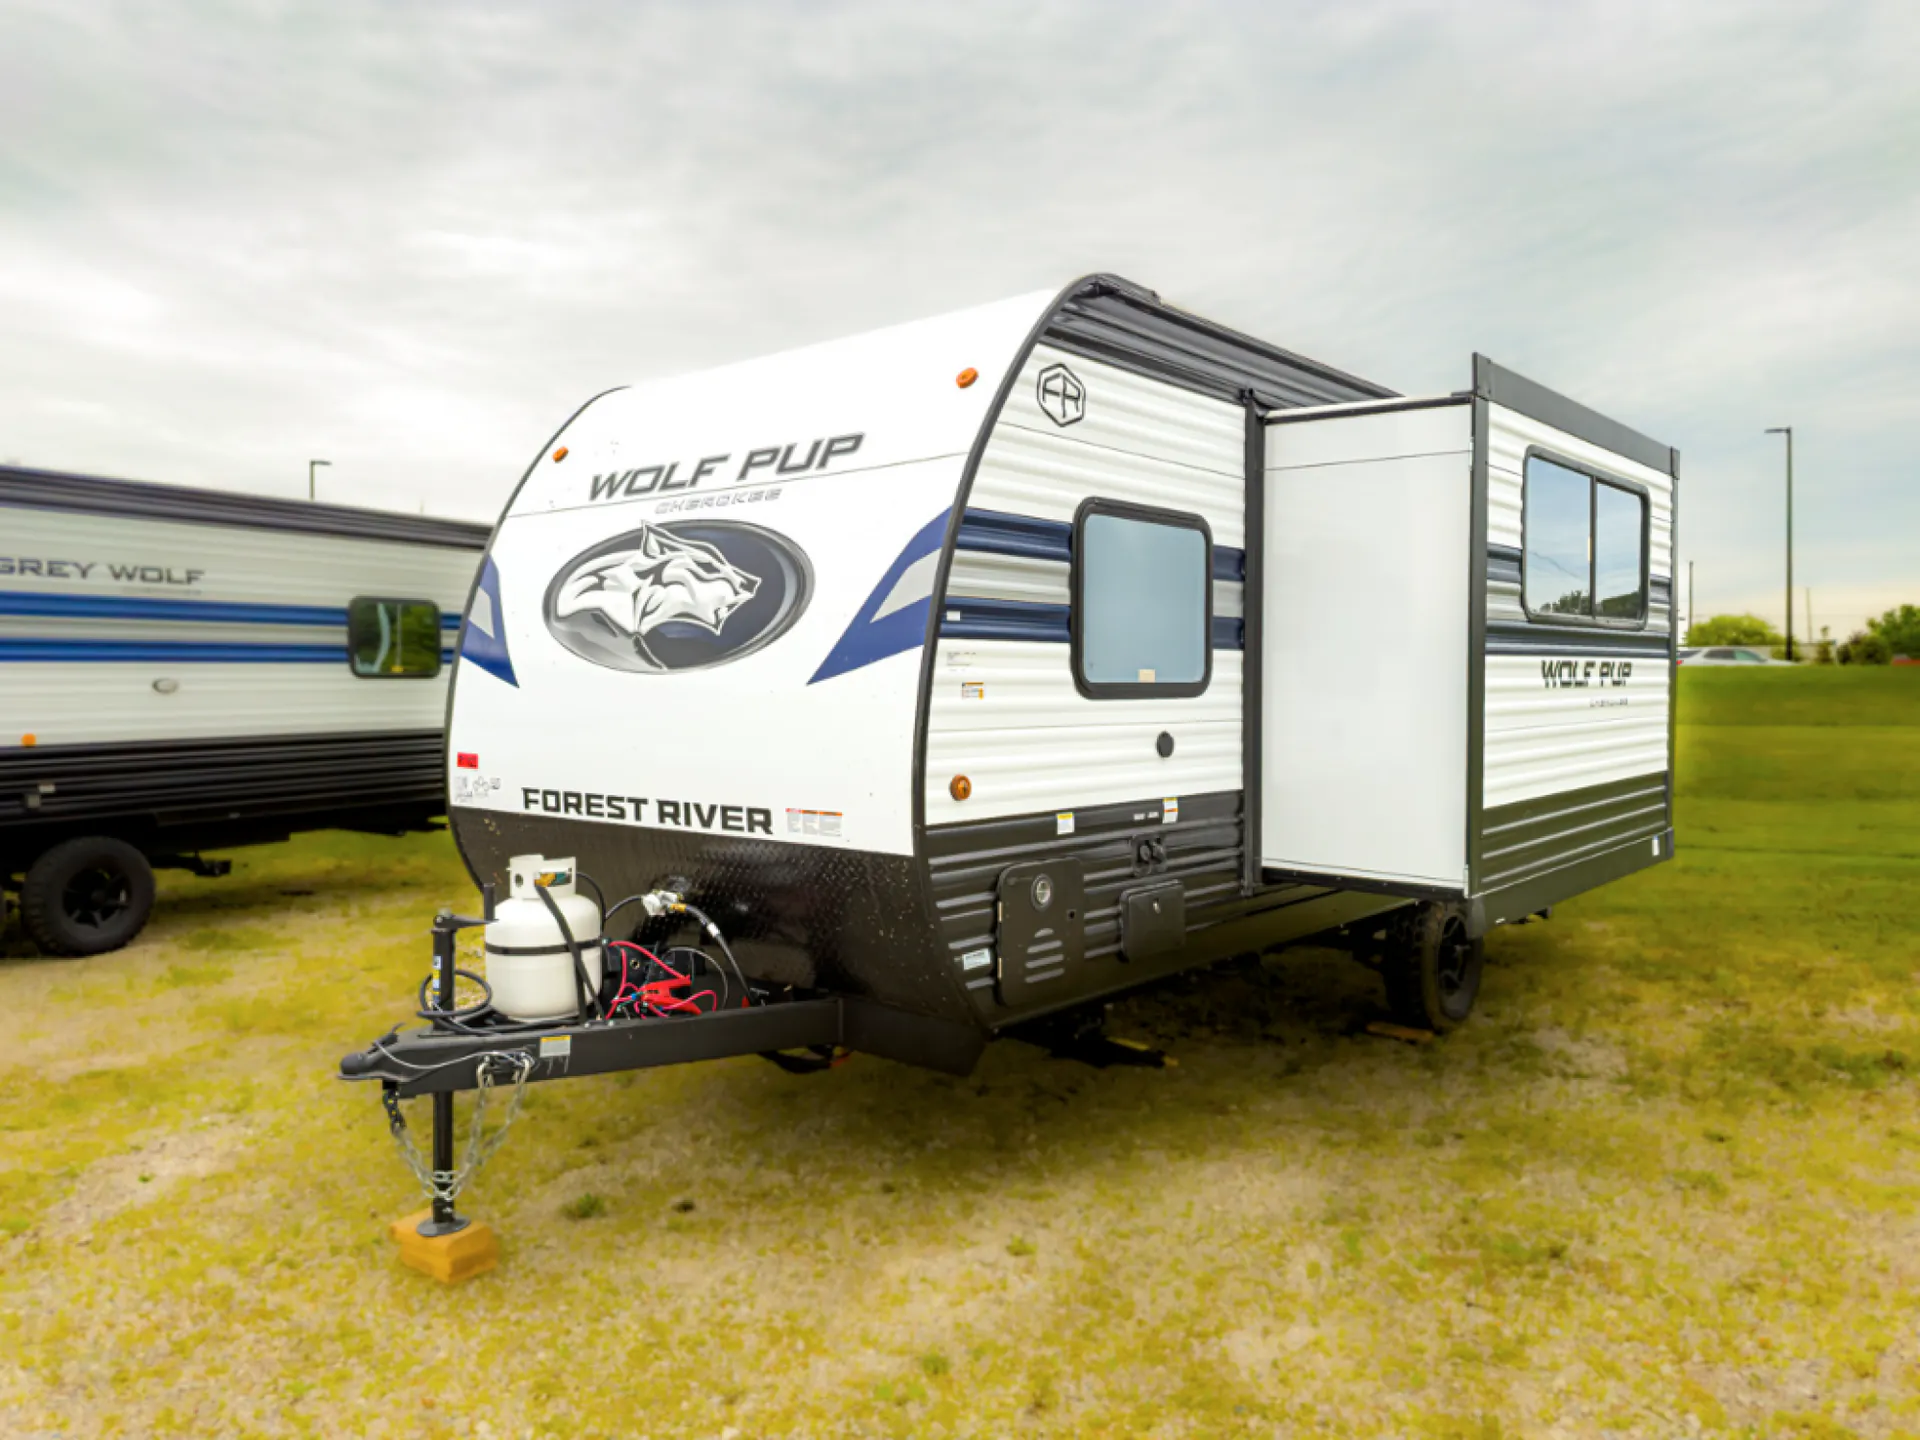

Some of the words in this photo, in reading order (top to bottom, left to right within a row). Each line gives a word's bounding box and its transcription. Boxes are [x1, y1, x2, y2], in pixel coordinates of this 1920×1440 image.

[589, 453, 732, 501] WOLF
[736, 432, 865, 481] PUP
[654, 488, 782, 514] CHEROKEE
[0, 557, 97, 580] GREY
[108, 564, 205, 585] WOLF
[1541, 660, 1596, 688] WOLF
[1599, 661, 1632, 687] PUP
[521, 787, 649, 821] FOREST
[656, 799, 773, 834] RIVER
